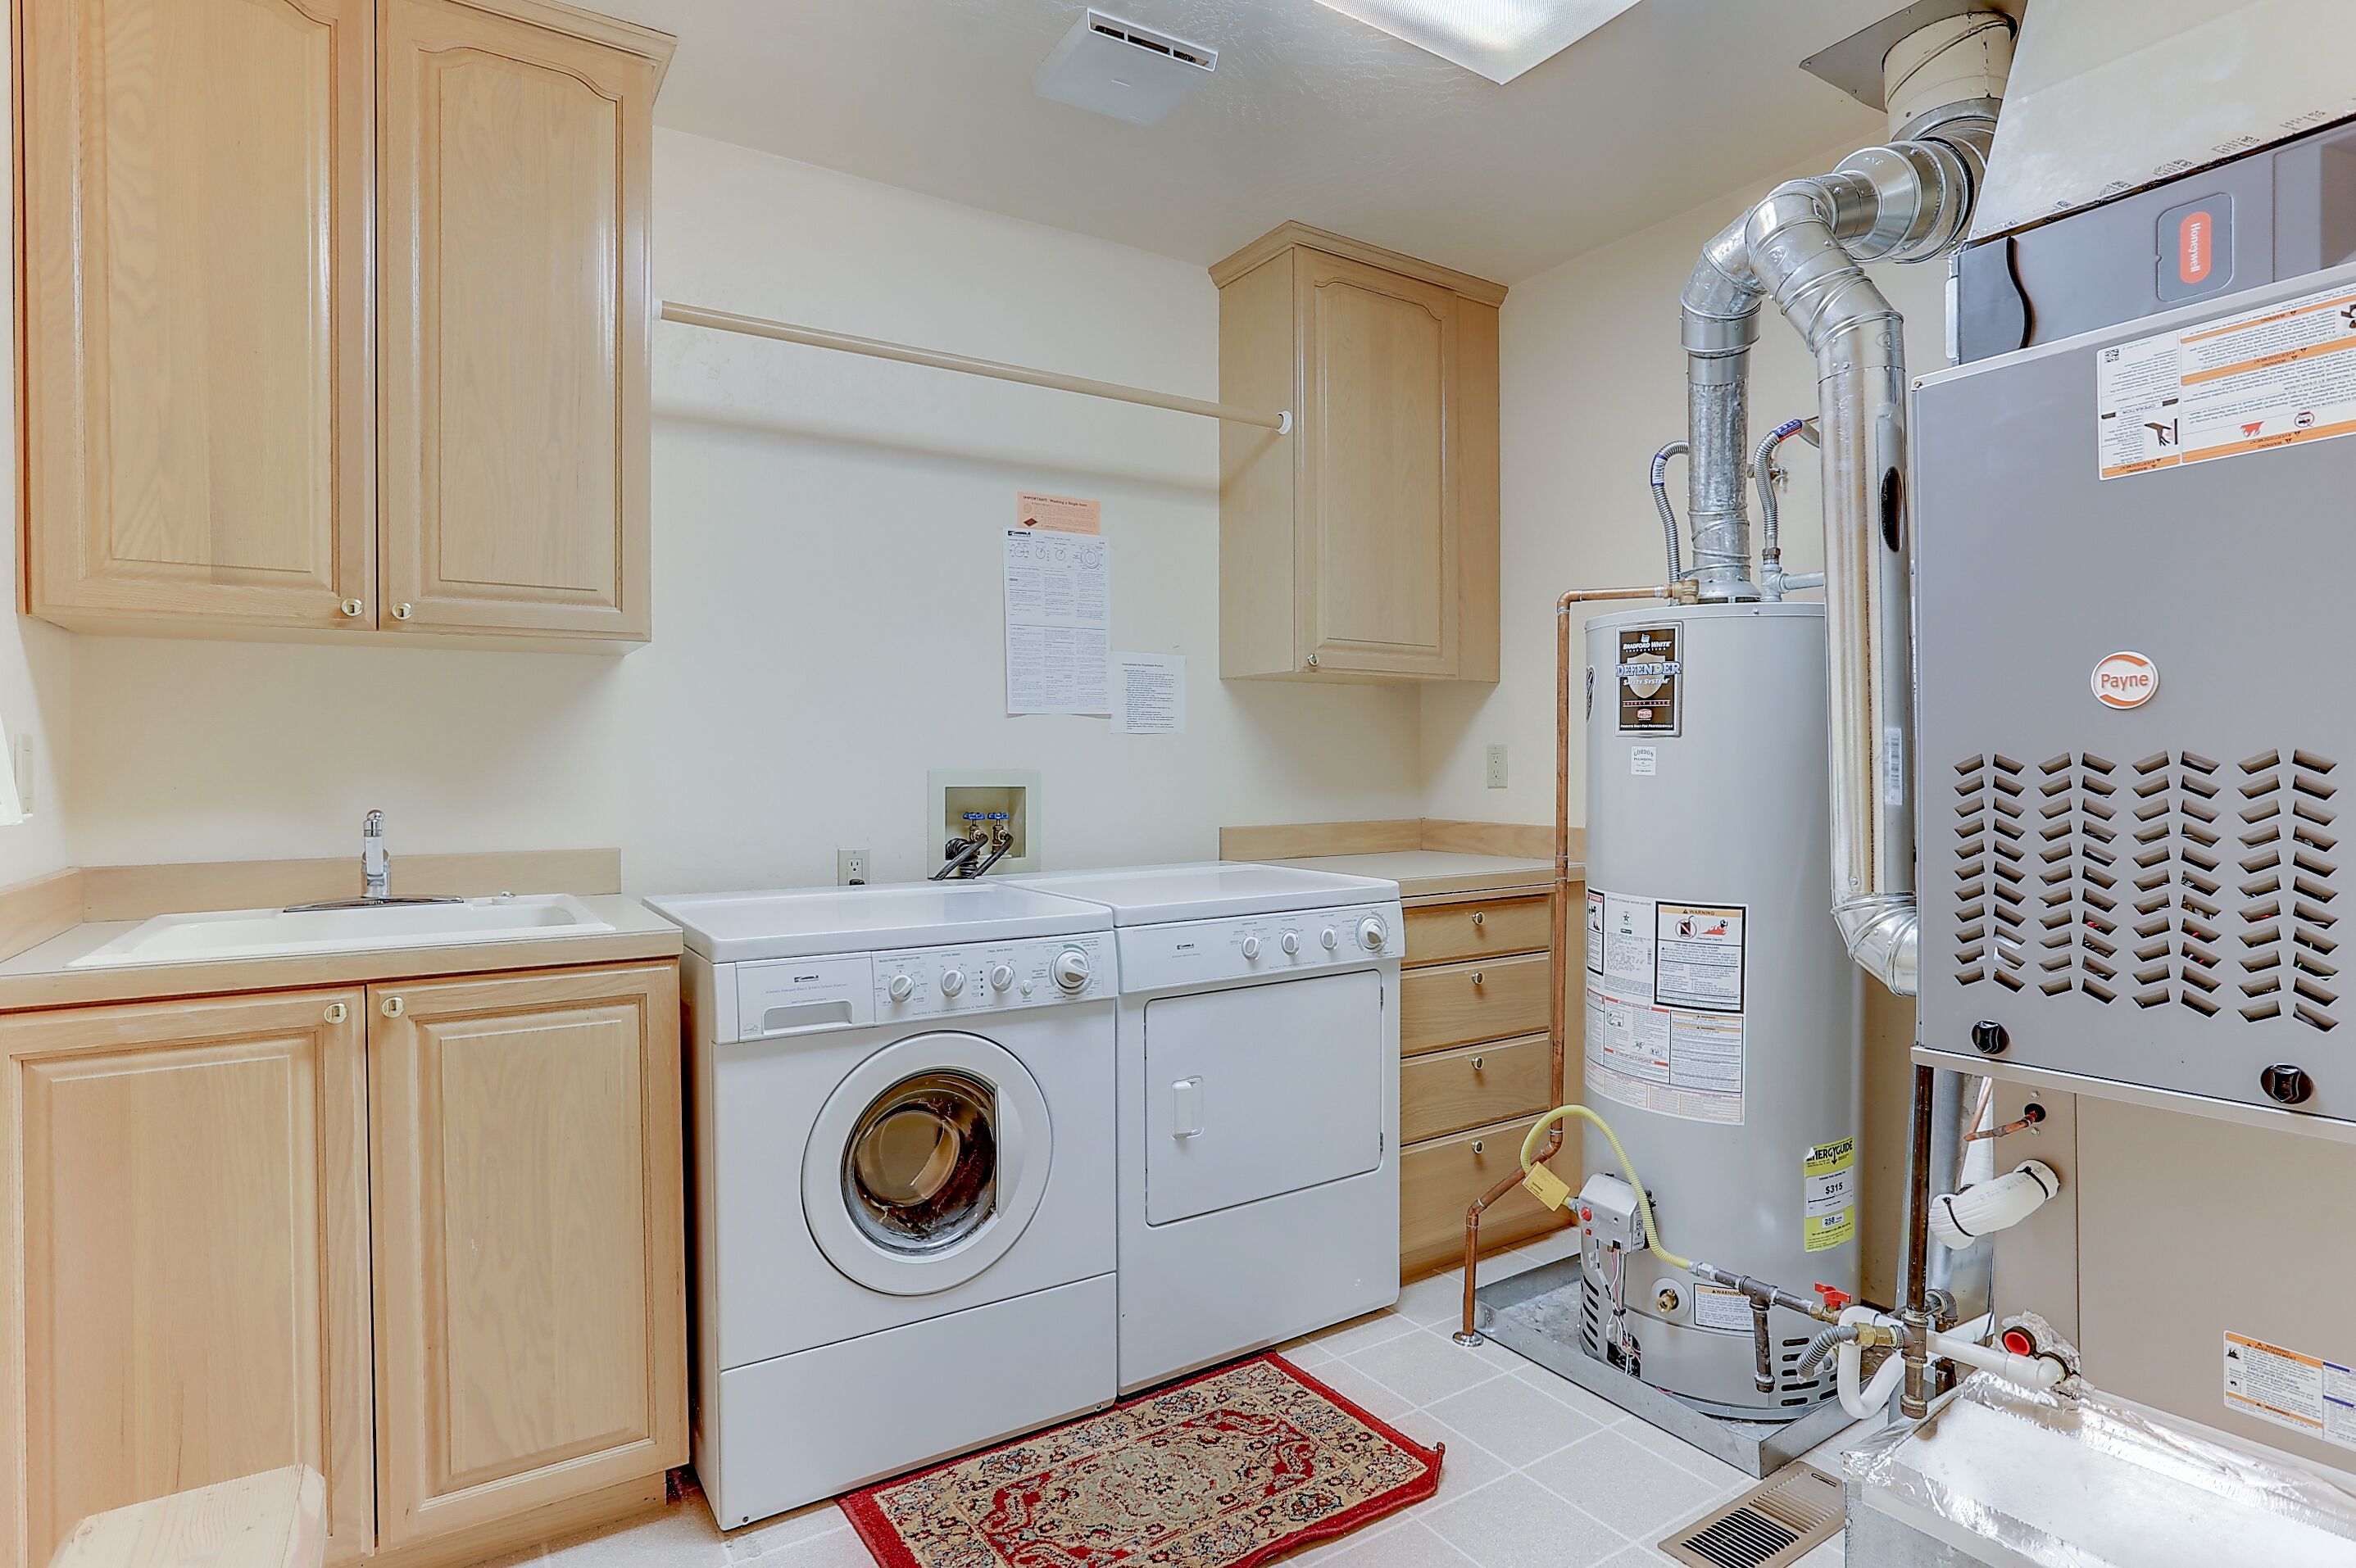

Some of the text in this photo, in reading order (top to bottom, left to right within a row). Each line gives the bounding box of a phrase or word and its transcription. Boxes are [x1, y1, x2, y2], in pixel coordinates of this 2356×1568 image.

[2189, 223, 2200, 273] Honeywell
[2122, 404, 2155, 416] OPERATION
[1616, 661, 1681, 677] DEFENDER
[2101, 674, 2148, 691] Payne
[1807, 1140, 1852, 1161] NERGYGUIDE
[1825, 1182, 1843, 1194] $315
